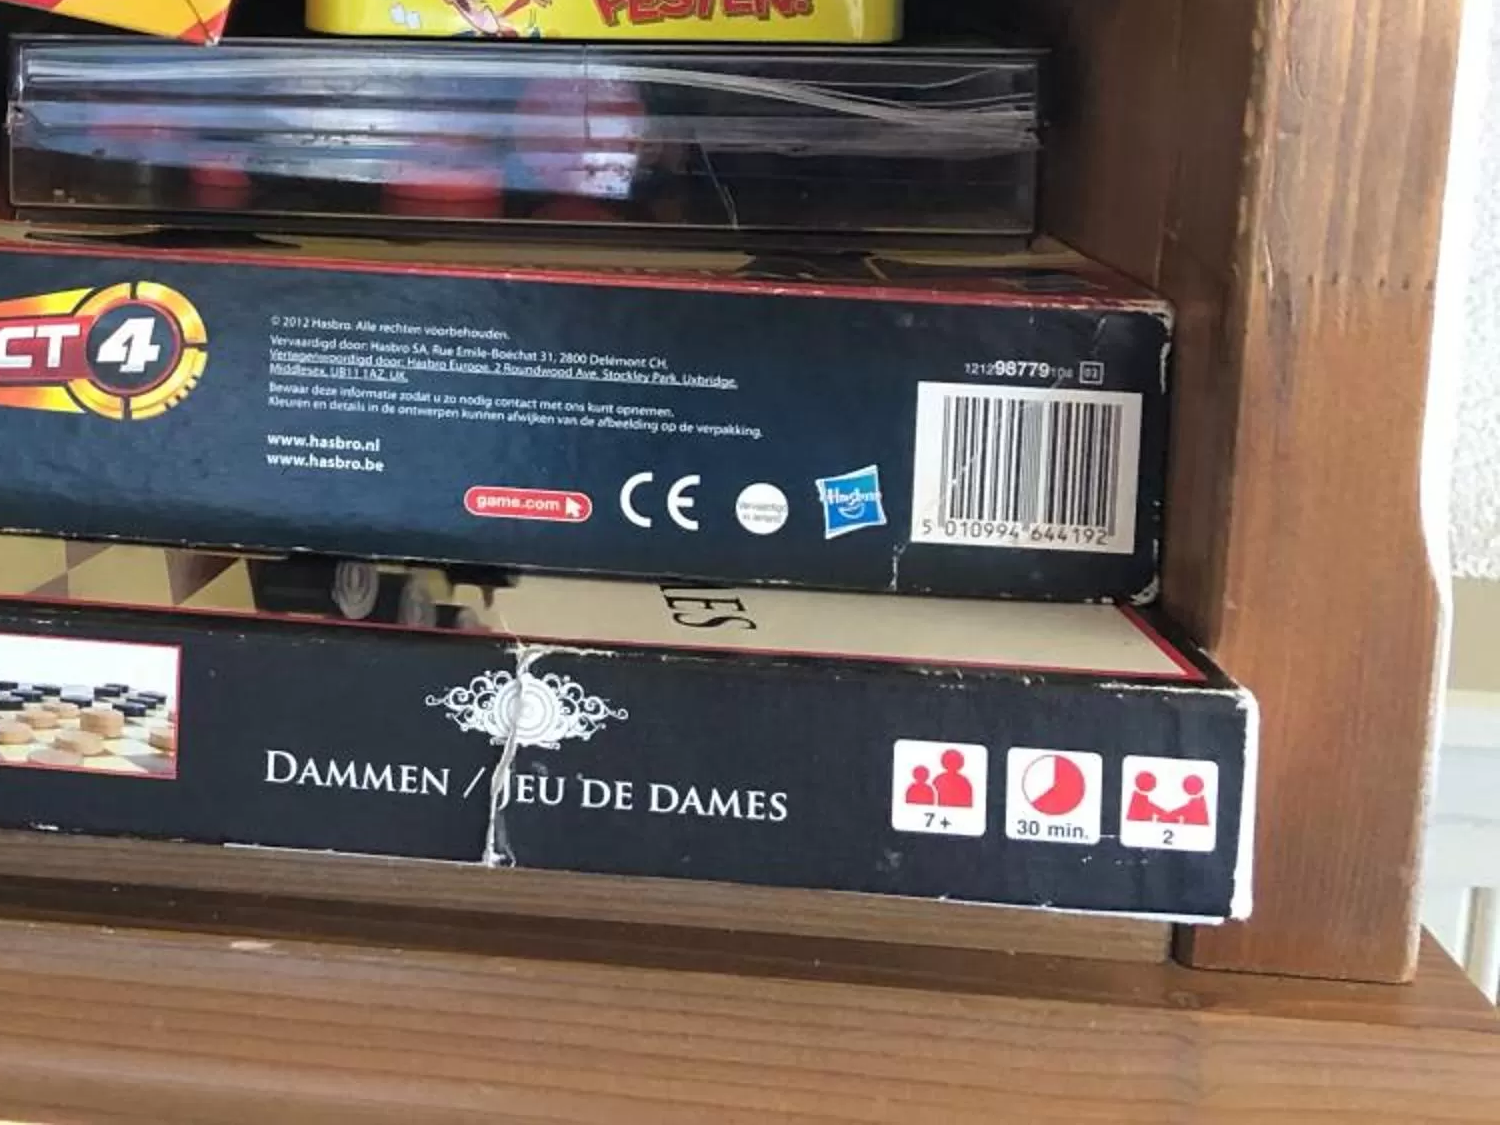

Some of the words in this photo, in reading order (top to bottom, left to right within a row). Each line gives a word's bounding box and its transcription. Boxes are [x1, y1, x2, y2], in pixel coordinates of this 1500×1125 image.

[283, 316, 310, 329] 2012
[356, 320, 377, 333] Alle
[96, 317, 161, 373] 4
[432, 344, 455, 357] Rue
[560, 352, 588, 365] 2800
[311, 384, 338, 396] deze
[459, 394, 493, 410] nodig
[494, 397, 538, 410] contact
[539, 399, 562, 411] met
[564, 401, 585, 412] ons
[587, 400, 614, 415] kunt
[313, 399, 327, 410] en
[367, 402, 379, 413] in
[381, 402, 396, 414] de
[461, 407, 505, 421] kunnen
[557, 415, 578, 427] van
[580, 415, 595, 427] de
[661, 422, 678, 433] op
[679, 421, 695, 433] de
[267, 433, 381, 452] www.hasbro.nl
[266, 452, 385, 472] www.hasbro.be
[476, 493, 561, 513] game.com
[923, 520, 932, 536] 5
[943, 519, 1020, 539] 010994
[1031, 525, 1110, 546] 644192
[1016, 820, 1041, 836] 30
[1047, 822, 1090, 839] min.
[1162, 829, 1174, 845] 2
